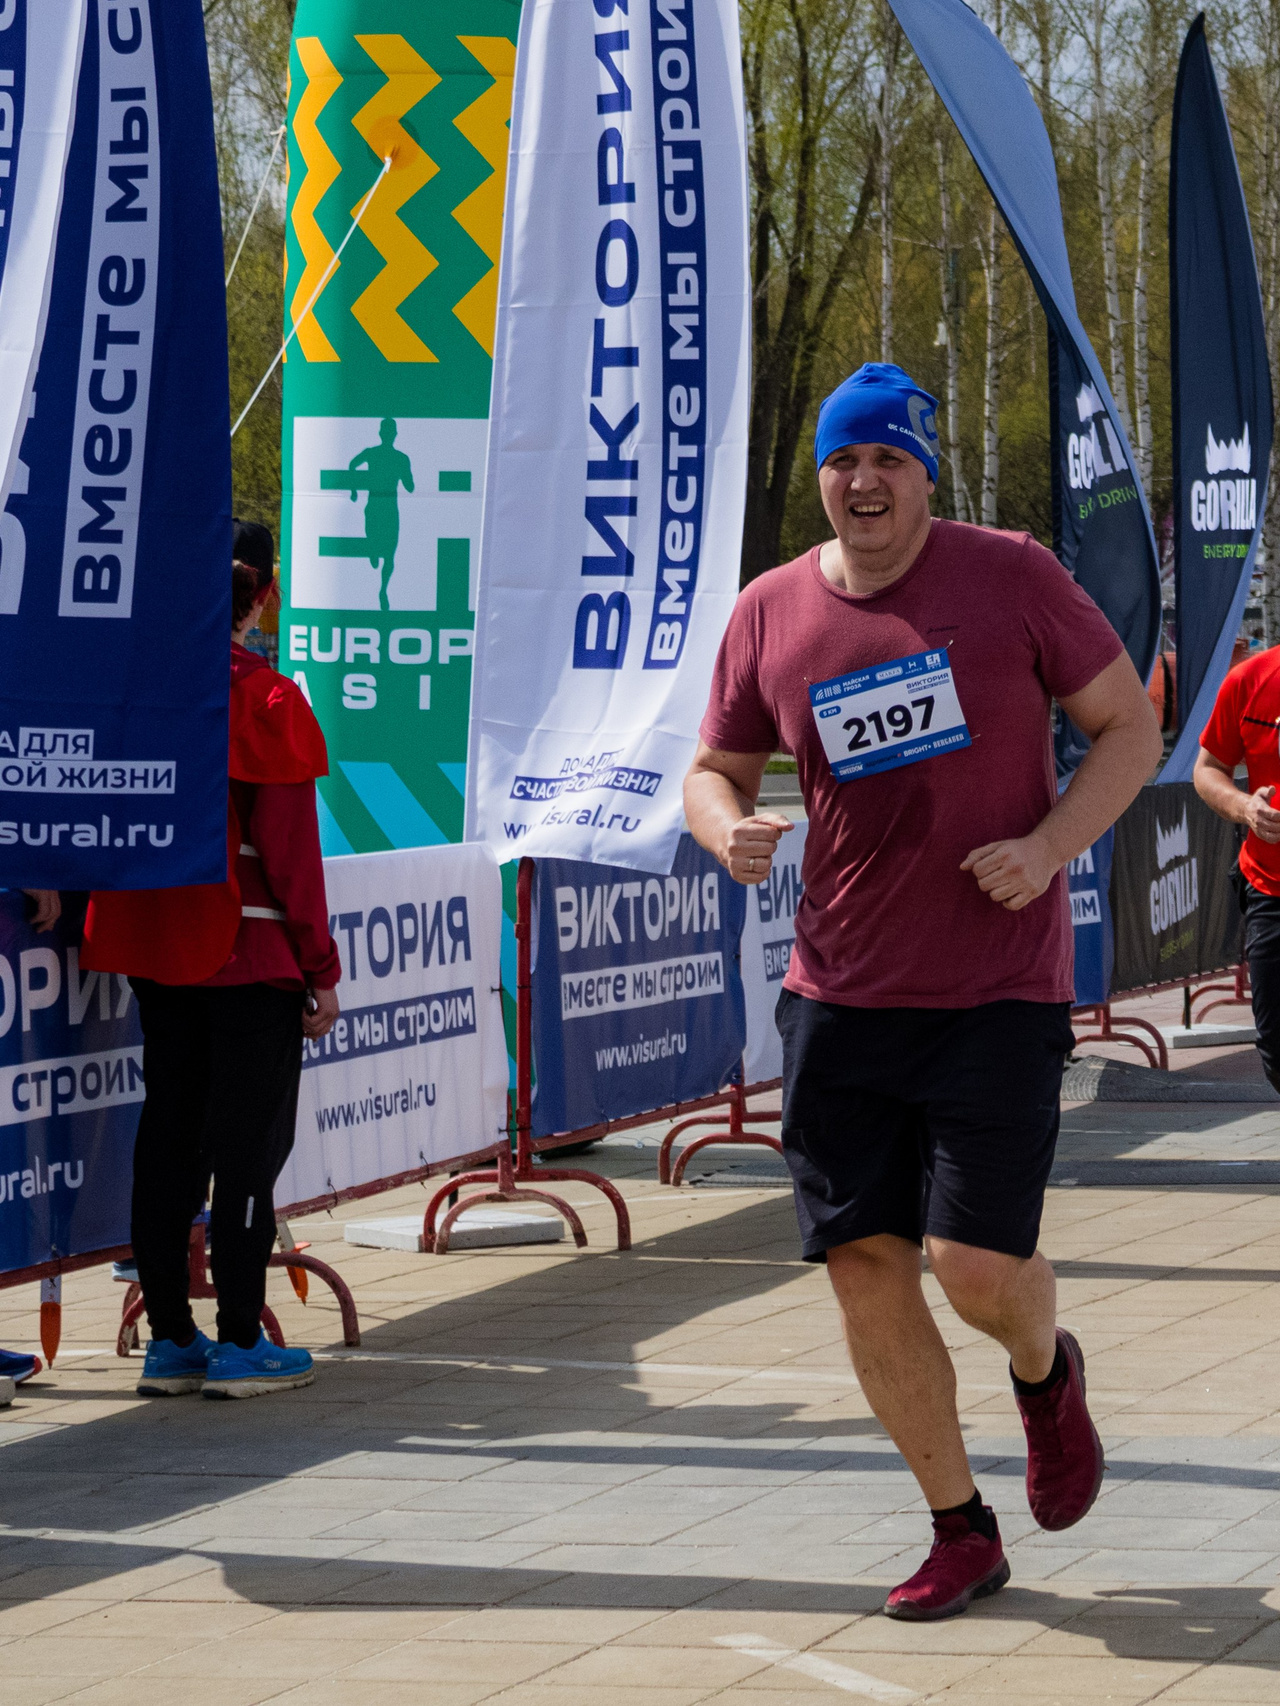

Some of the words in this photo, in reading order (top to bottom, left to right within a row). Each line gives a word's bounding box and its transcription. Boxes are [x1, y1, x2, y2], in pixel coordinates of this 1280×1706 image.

[573, 0, 640, 670] ВИКТОРИ
[1191, 478, 1257, 531] GORILLA
[906, 672, 949, 690] ВИКТОРИЯ
[24, 732, 91, 757] ДЛЯ
[842, 695, 936, 752] 2197
[57, 766, 174, 789] ЖИЗНИ
[555, 872, 721, 952] ВИКТОРИЯ
[1150, 857, 1199, 936] GORILLA
[596, 1027, 687, 1072] www.visural.ru
[316, 1078, 436, 1133] www.visural.ru
